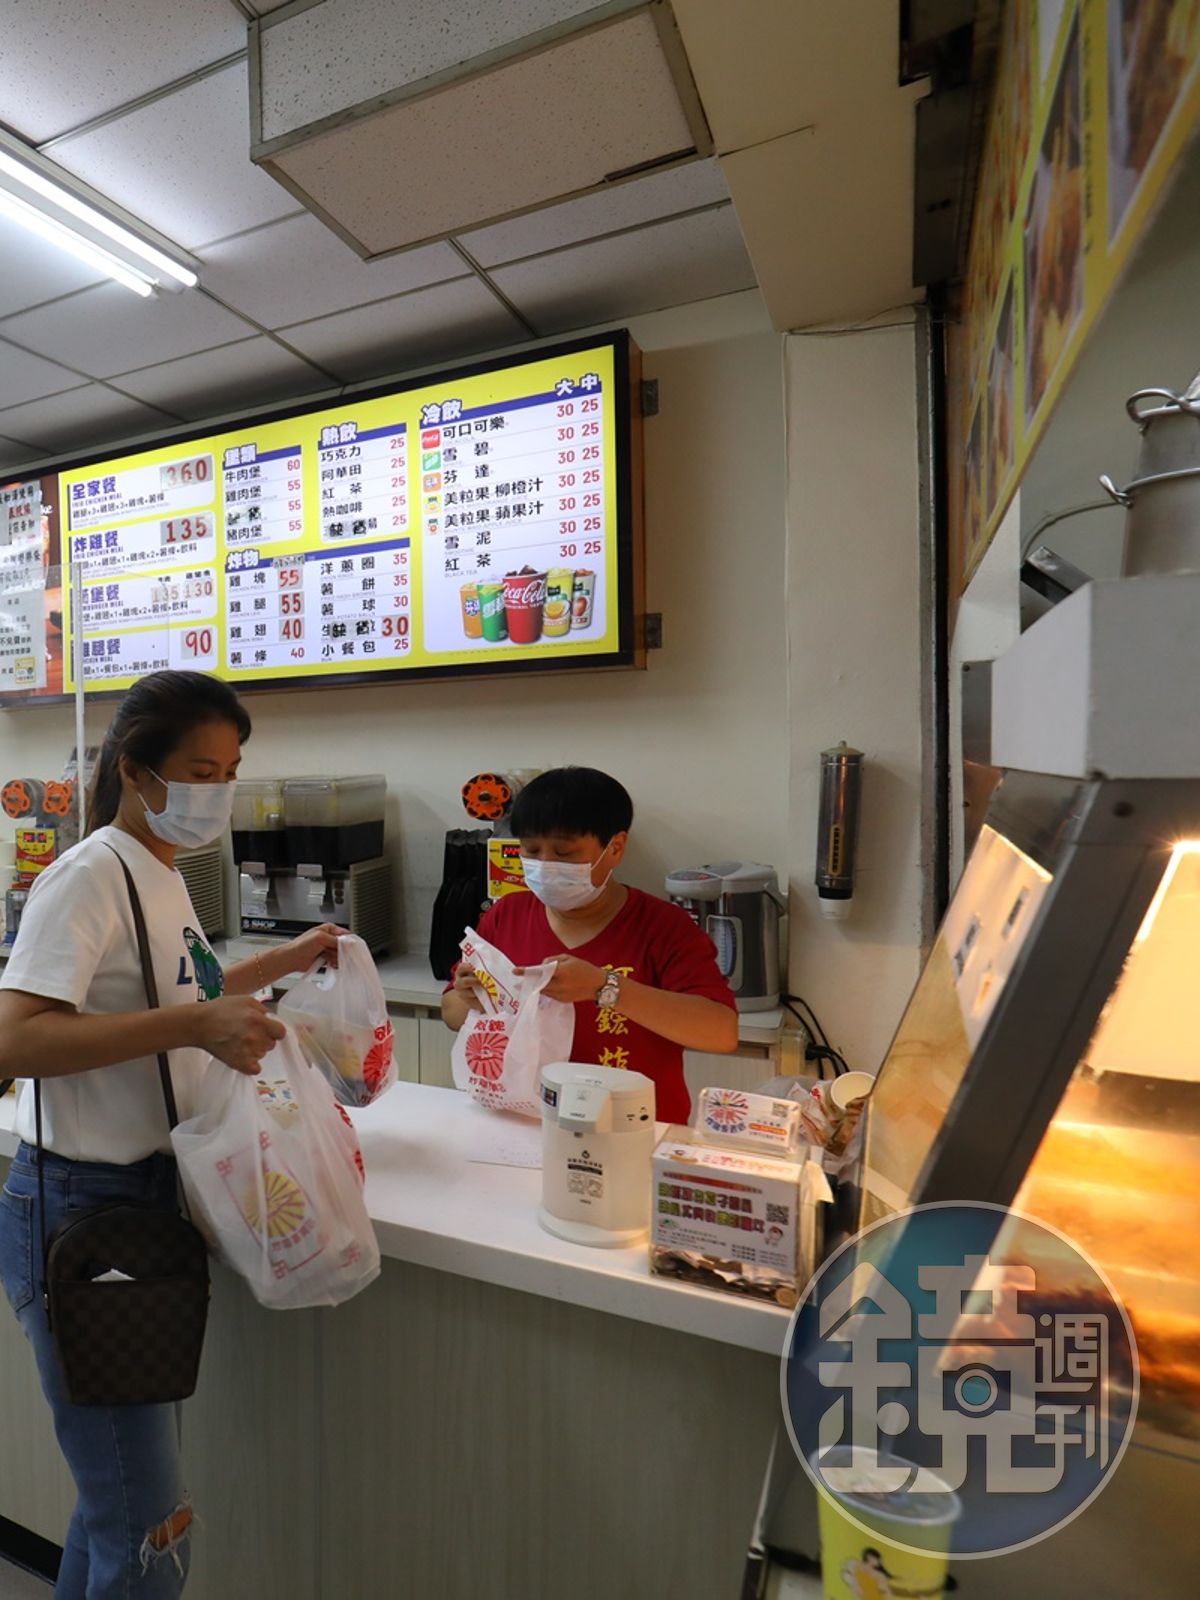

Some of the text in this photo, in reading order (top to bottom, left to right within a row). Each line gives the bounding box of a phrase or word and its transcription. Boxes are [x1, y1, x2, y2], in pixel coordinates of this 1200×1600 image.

[422, 374, 597, 424] 冷飲 大 中
[443, 416, 505, 439] 可口可樂
[557, 403, 574, 418] 30
[581, 399, 598, 413] 25
[558, 427, 574, 441] 30
[582, 423, 599, 437] 25
[321, 438, 405, 462] 巧克力 25
[558, 450, 575, 465] 30
[582, 446, 599, 461] 25
[225, 459, 300, 482] 牛肉堡 60
[322, 457, 405, 481] 阿華田 25
[226, 480, 301, 502] 雞肉堡 55
[322, 476, 406, 499] 紅茶 25
[444, 469, 600, 506] 美粒果 柳橙汁 30 25
[289, 500, 301, 511] 55
[323, 496, 406, 517] 熱咖啡 25
[444, 493, 600, 529] 美粒果 蘋果汁 30 25
[166, 516, 207, 543] 135
[289, 520, 302, 531] 55
[393, 515, 406, 526] 25
[559, 521, 576, 535] 30
[583, 516, 601, 531] 25
[228, 550, 259, 569] 炸物
[393, 553, 407, 565] 35
[445, 540, 601, 572] 紅茶 30 25
[279, 569, 299, 587] 55
[393, 574, 407, 586] 35
[282, 593, 301, 614] 55
[394, 595, 408, 607] 30
[283, 619, 302, 639] 40
[382, 616, 409, 636] 30
[185, 629, 211, 656] 90
[291, 647, 305, 658] 40
[321, 638, 408, 656] 小餐包 25
